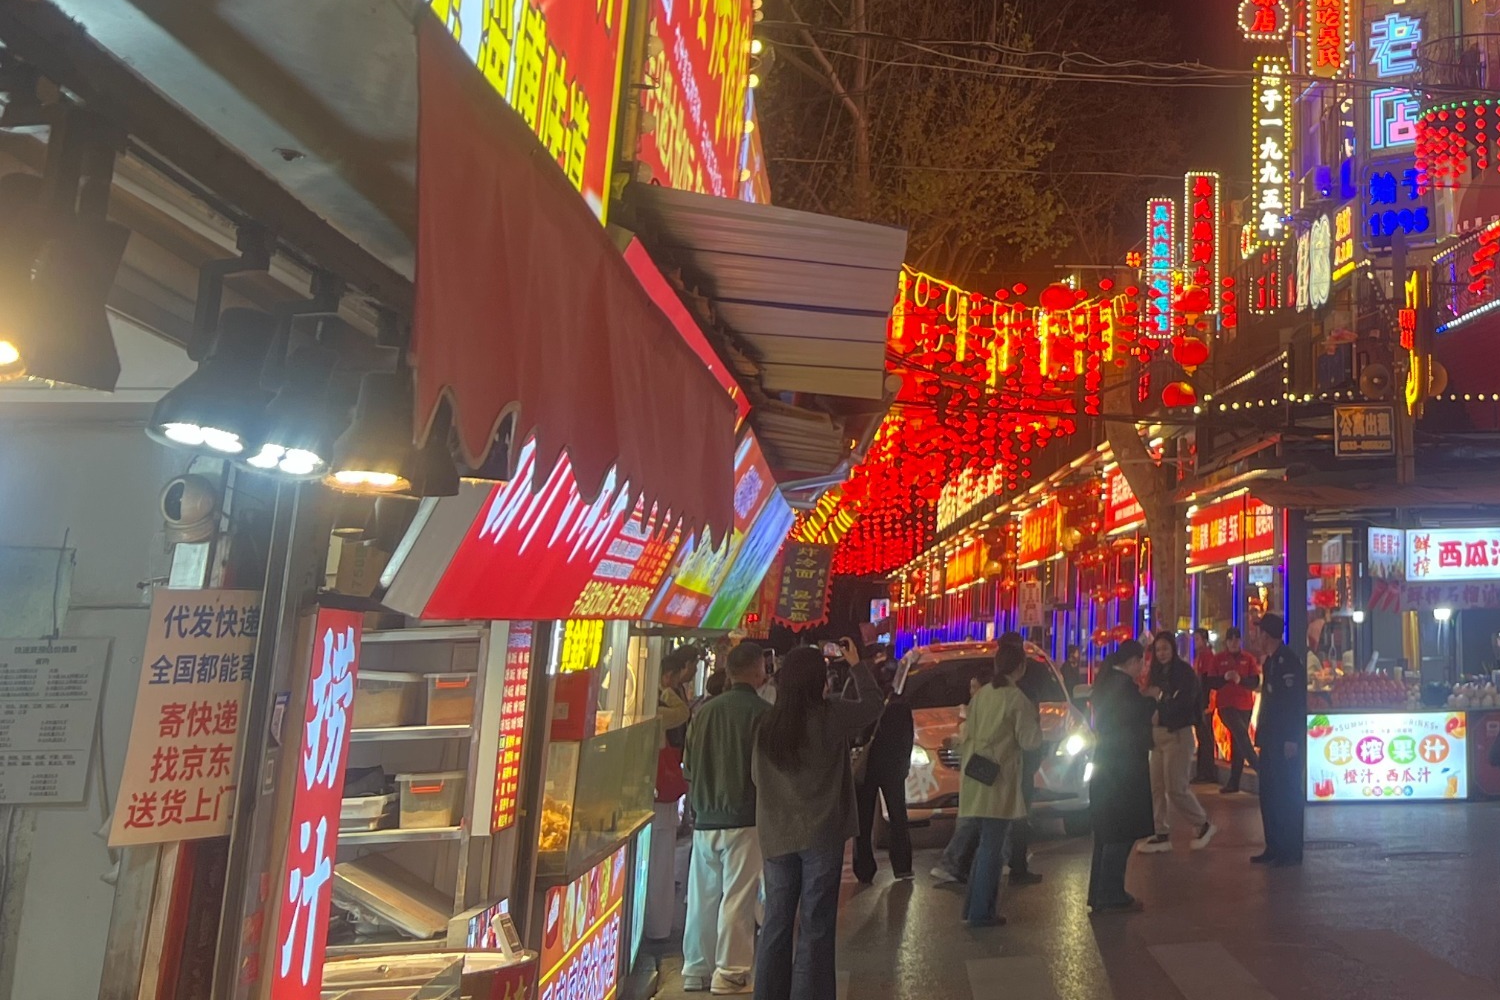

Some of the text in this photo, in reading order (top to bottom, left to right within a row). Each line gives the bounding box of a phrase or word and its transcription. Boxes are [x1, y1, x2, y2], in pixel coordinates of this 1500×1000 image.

[1369, 206, 1429, 236] 1995
[1411, 534, 1431, 577] 鲜榨
[164, 605, 261, 639] 代发快递
[149, 654, 255, 685] 全国都能寄
[158, 700, 239, 738] 寄快递
[150, 743, 233, 783] 找京东
[1328, 738, 1446, 763] 鲜榨果汁
[124, 785, 237, 830] 送货上门
[281, 626, 355, 987] 捞汁
